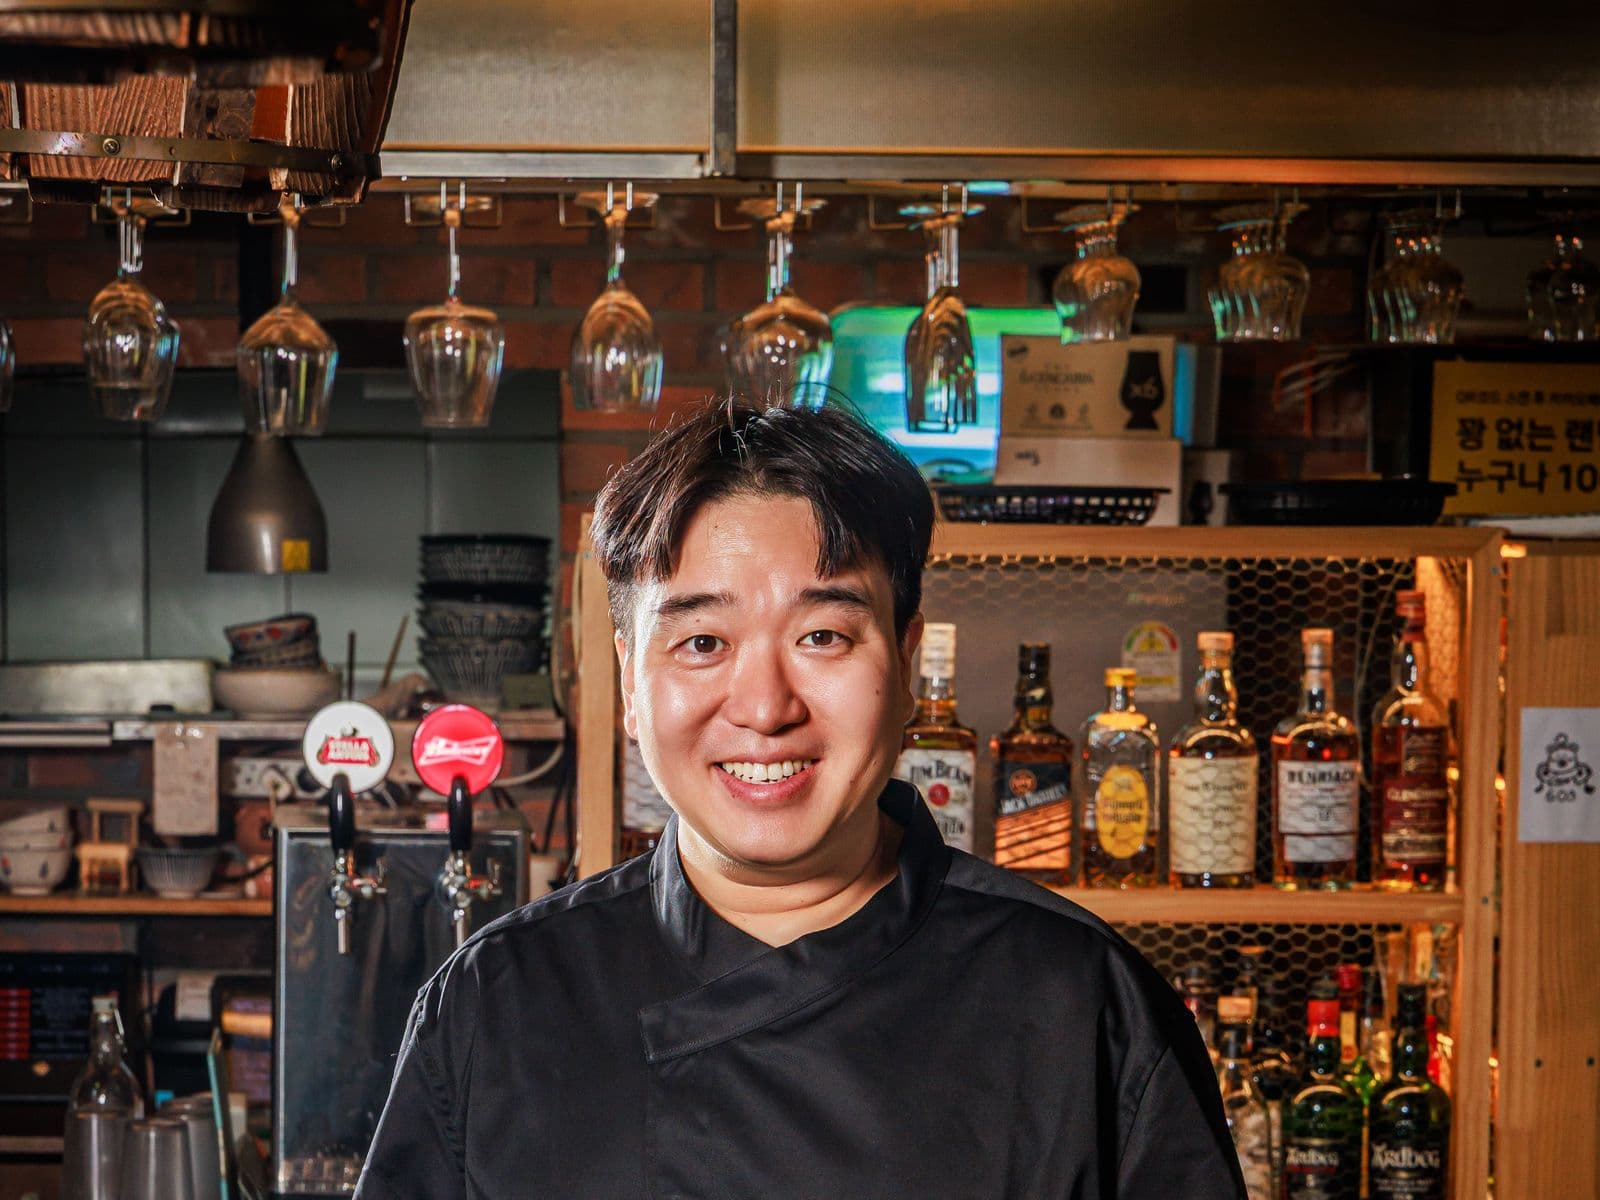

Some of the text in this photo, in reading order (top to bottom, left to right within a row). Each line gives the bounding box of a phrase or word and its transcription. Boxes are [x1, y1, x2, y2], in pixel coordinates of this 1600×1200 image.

[1496, 417, 1556, 452] 없는
[1566, 418, 1600, 452] 랜
[1456, 460, 1547, 494] 누구나
